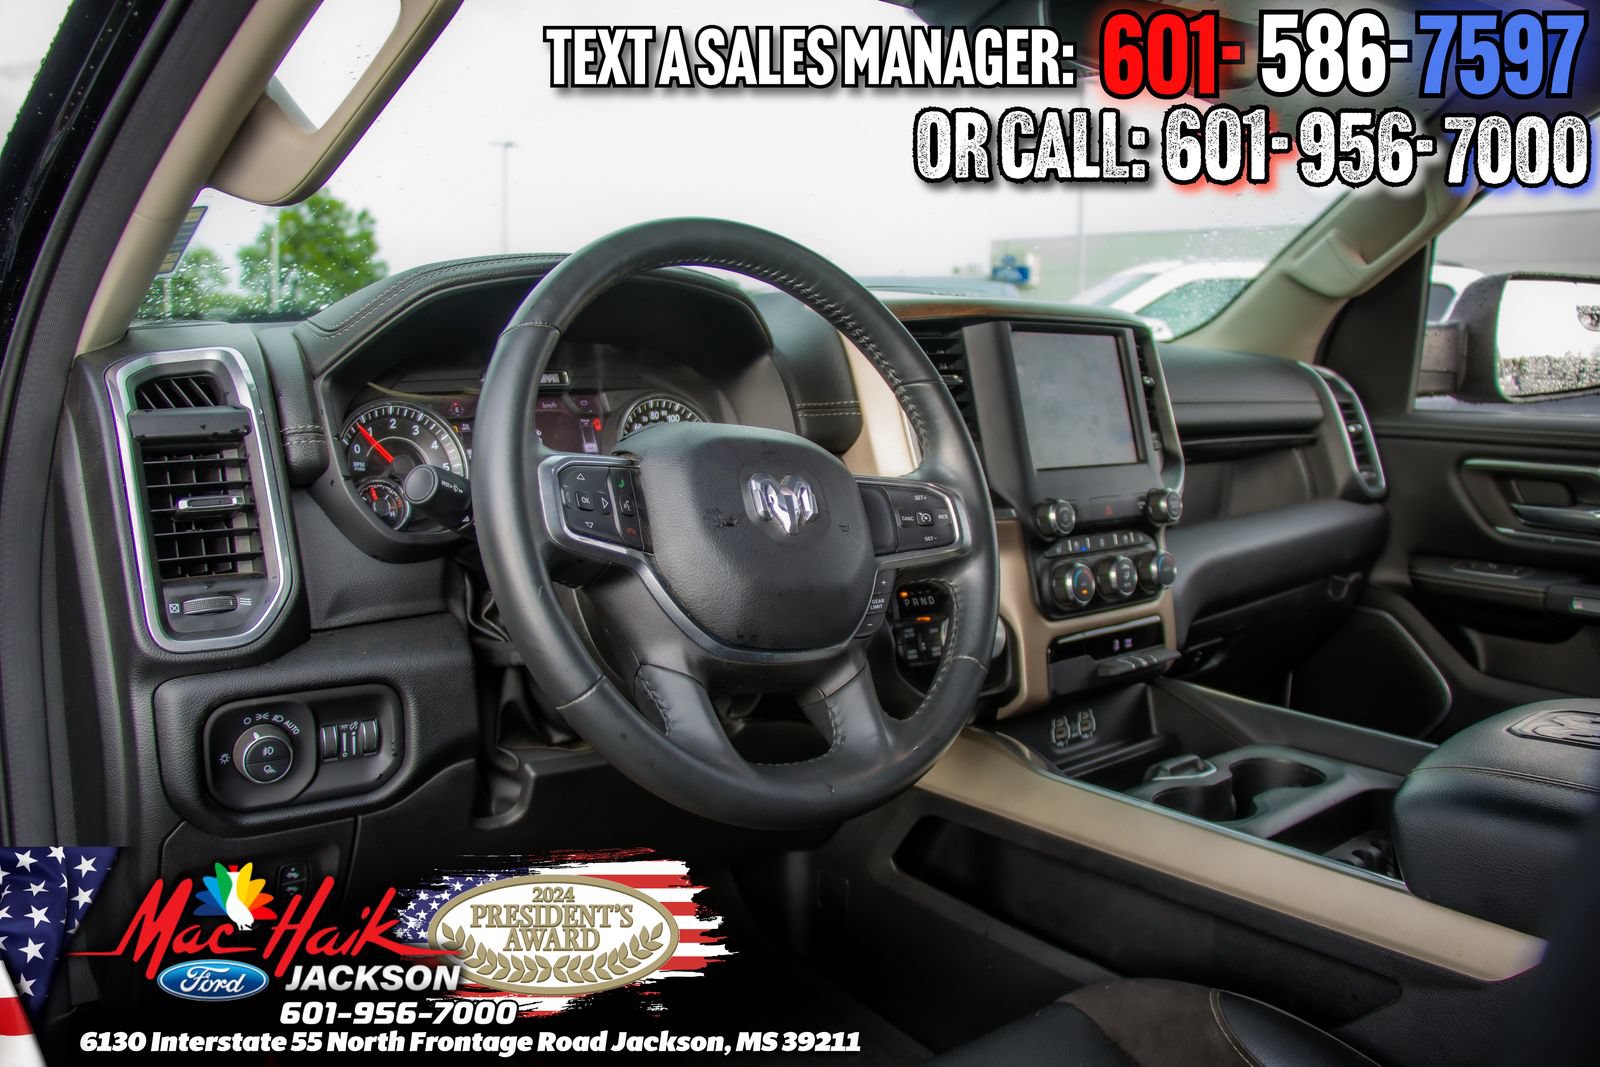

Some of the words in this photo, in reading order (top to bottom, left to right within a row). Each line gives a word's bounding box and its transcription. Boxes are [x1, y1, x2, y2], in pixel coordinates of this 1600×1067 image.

[650, 410, 660, 420] 80
[667, 413, 681, 423] 100
[389, 418, 397, 430] 2
[411, 425, 420, 436] 3
[353, 443, 361, 455] 0
[431, 440, 439, 450] 4
[442, 462, 450, 471] 5
[581, 496, 591, 505] OK
[283, 719, 300, 735] AUTO
